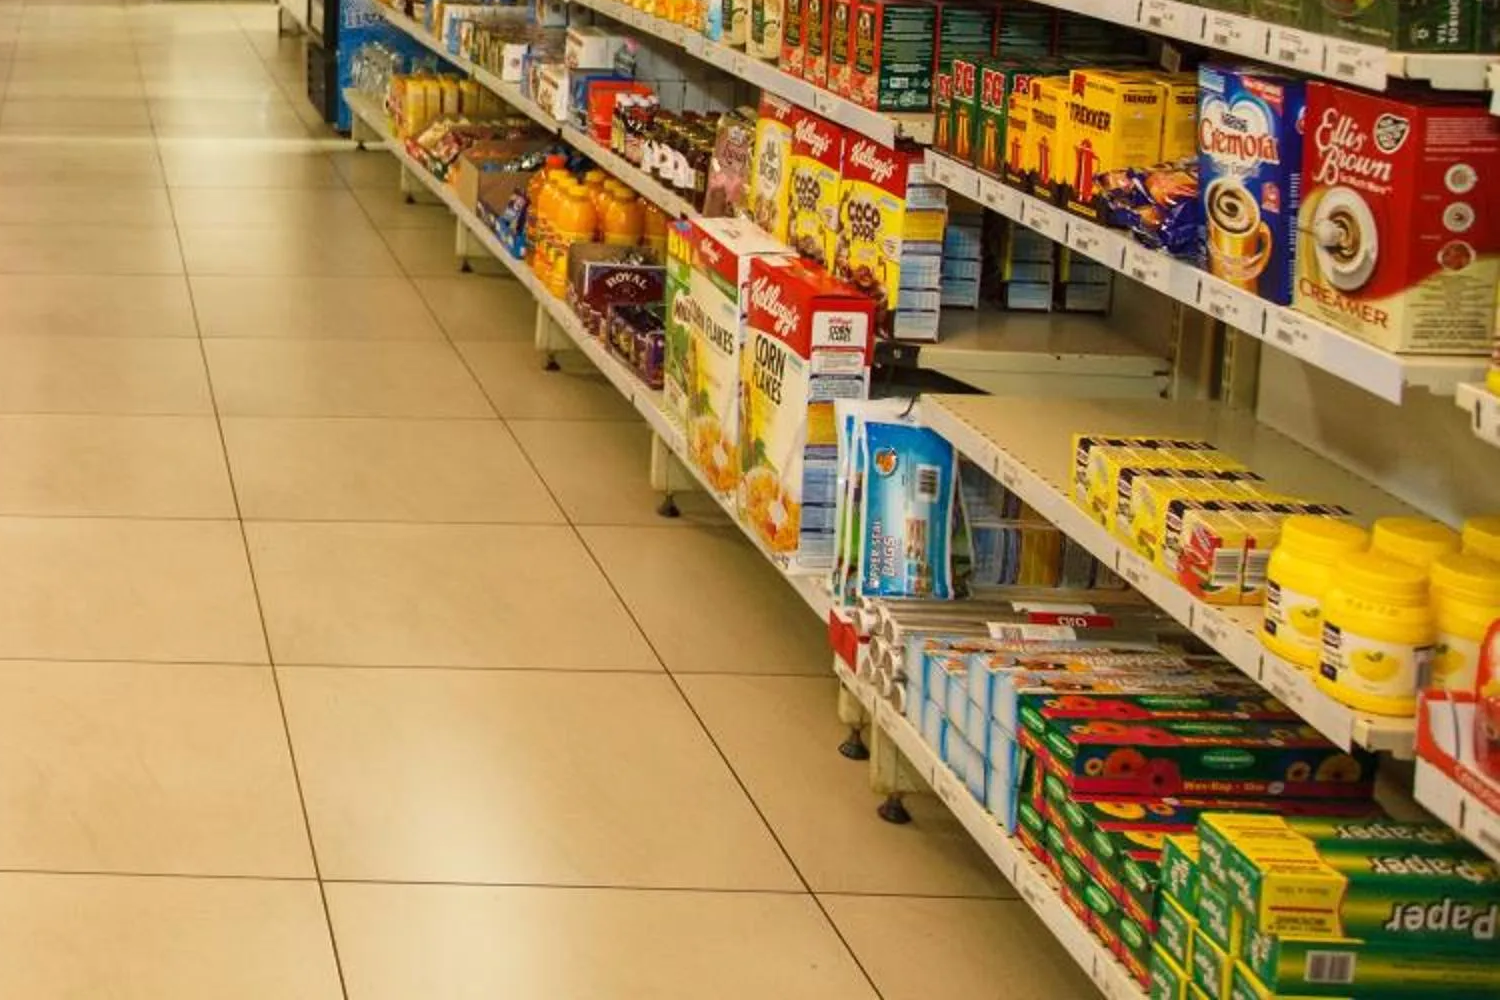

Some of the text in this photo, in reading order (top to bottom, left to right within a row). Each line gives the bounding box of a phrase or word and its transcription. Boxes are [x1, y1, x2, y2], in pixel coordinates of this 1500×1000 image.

[1437, 24, 1448, 44] TEA
[794, 117, 832, 157] Kellogg's
[1069, 101, 1112, 132] TREKKER
[1315, 107, 1367, 153] Ellis
[1200, 117, 1278, 161] Cremora
[851, 139, 898, 184] Kellogg's
[1313, 145, 1393, 185] Brown
[847, 200, 881, 229] COCO
[605, 271, 648, 291] ROYAL
[751, 275, 800, 337] Kellogg's
[1299, 277, 1389, 328] CREAMER
[705, 316, 734, 356] FLAKES
[828, 324, 852, 335] CORN
[755, 334, 787, 381] CORN
[753, 362, 783, 406] FLAKES
[883, 535, 895, 577] BAGS
[1369, 854, 1485, 883] Paper
[1385, 897, 1498, 940] Paper
